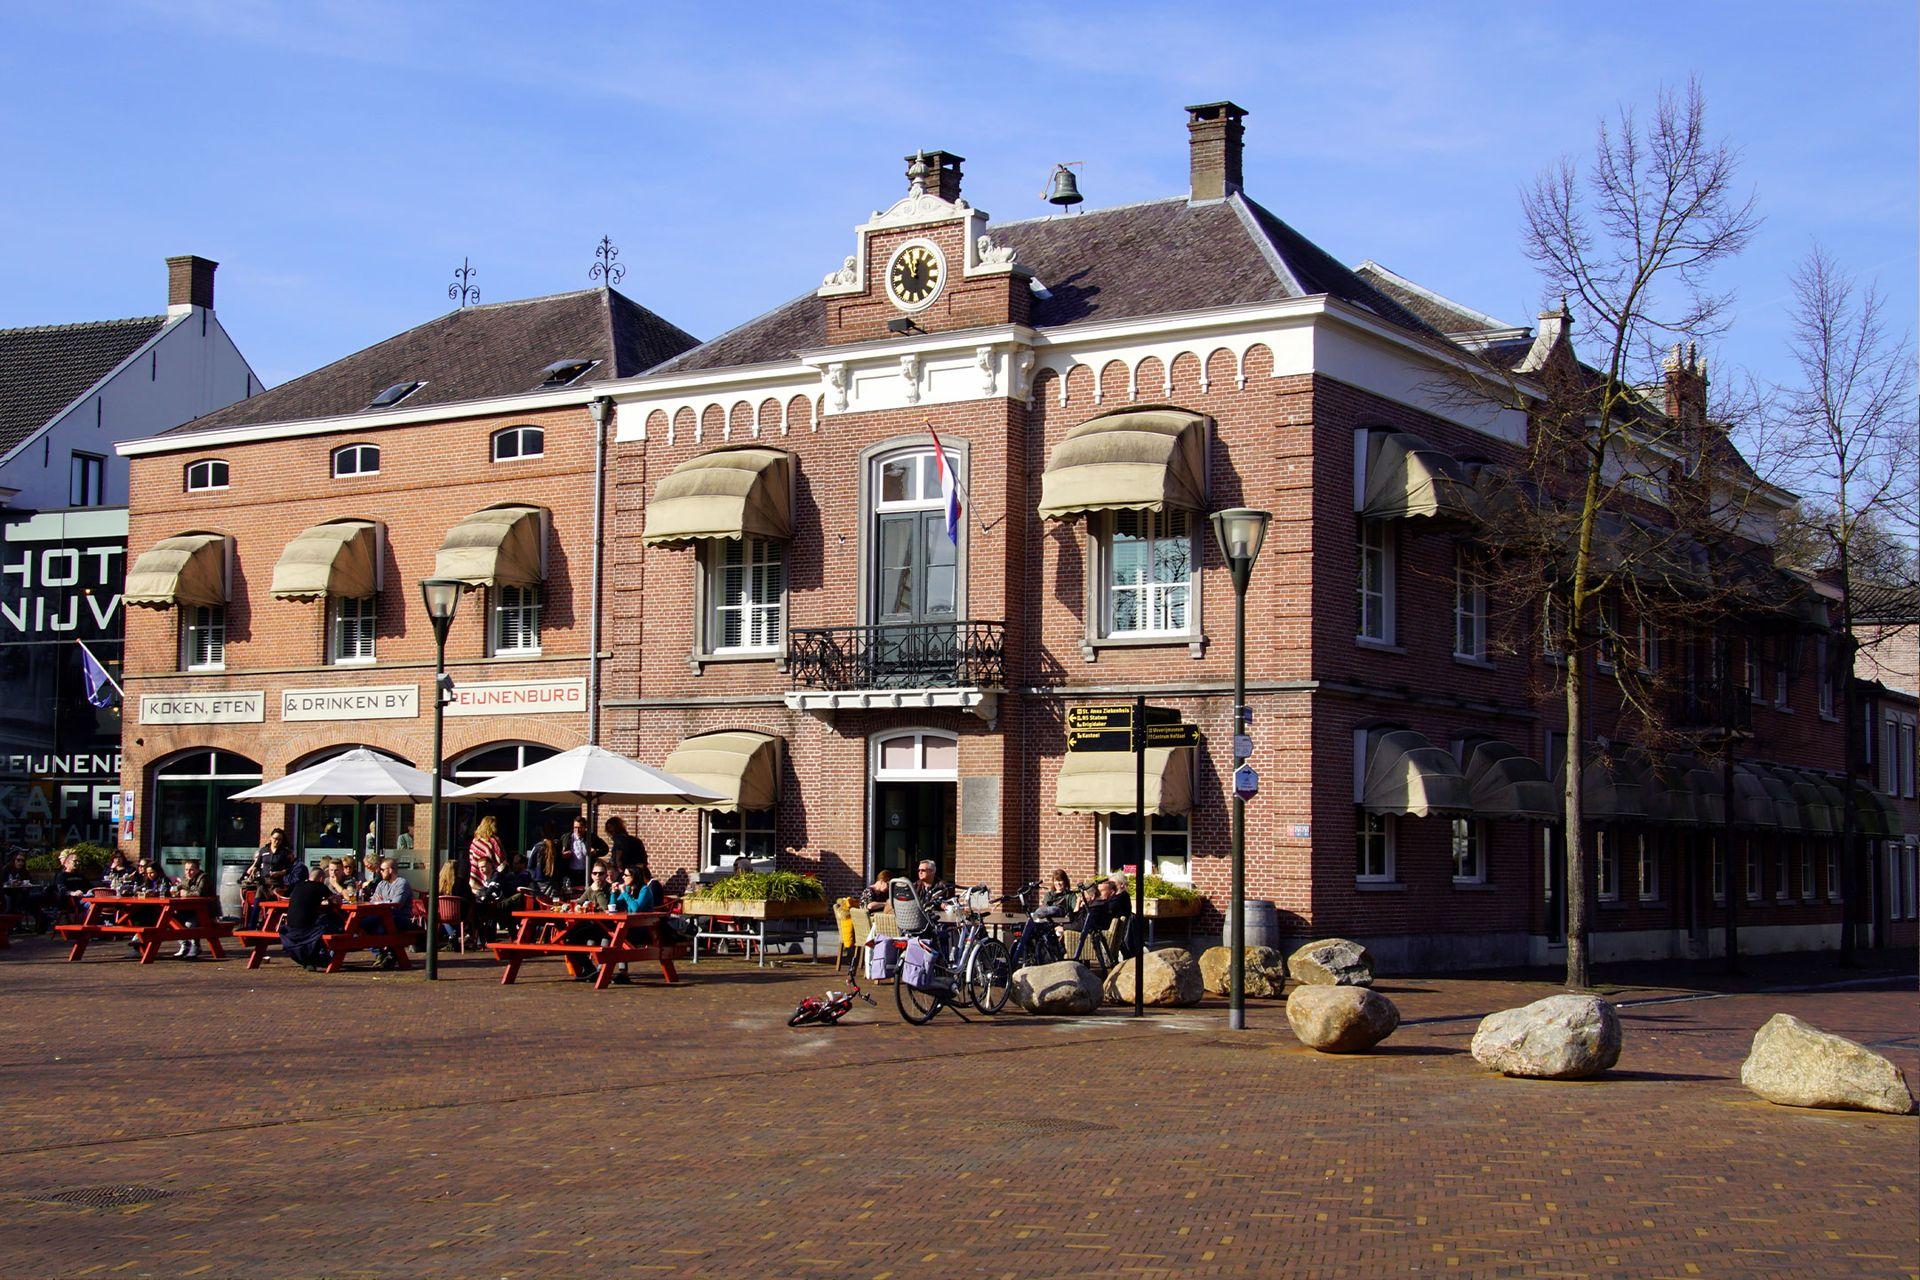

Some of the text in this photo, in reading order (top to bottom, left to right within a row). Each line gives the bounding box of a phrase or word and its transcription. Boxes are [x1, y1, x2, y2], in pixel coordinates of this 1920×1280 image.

[150, 700, 256, 715] KOKEN, ETEN
[286, 695, 409, 711] & DRINKEN BY
